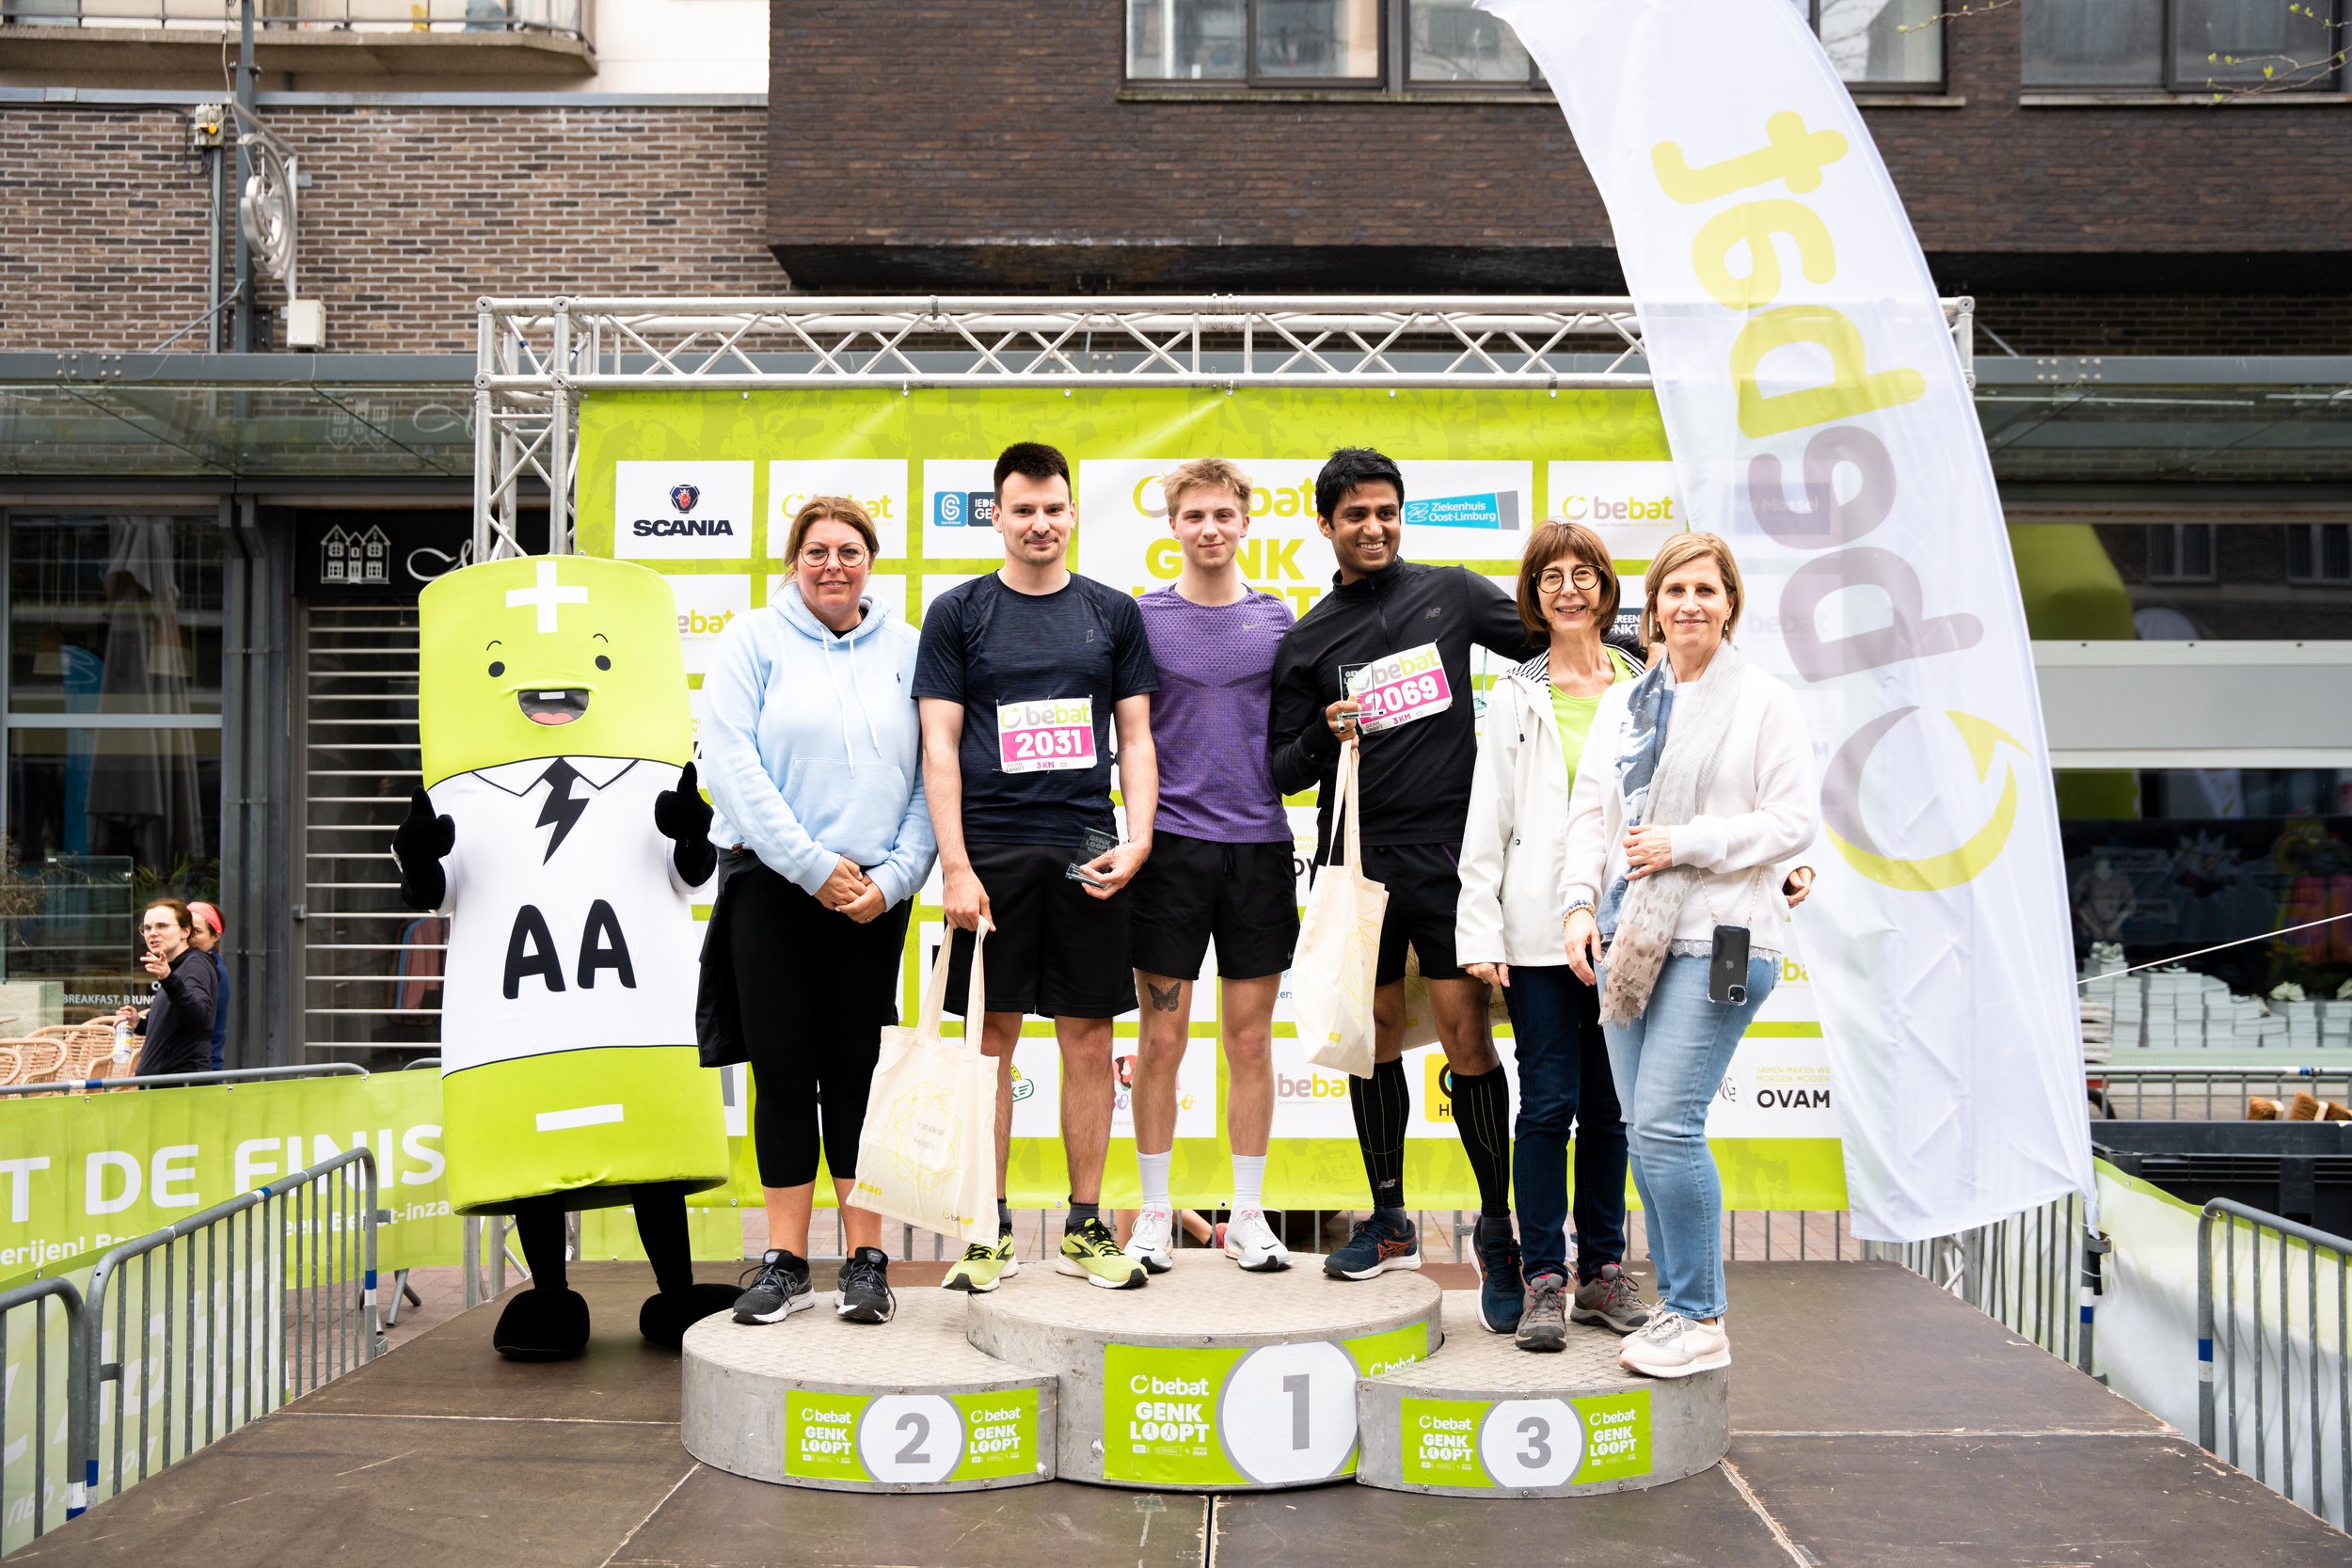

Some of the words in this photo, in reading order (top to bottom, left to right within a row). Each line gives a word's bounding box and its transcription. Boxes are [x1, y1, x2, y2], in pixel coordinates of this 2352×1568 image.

[1249, 477, 1318, 517] bat
[975, 508, 993, 519] GE
[1432, 502, 1486, 512] Ziekenhuis
[1594, 496, 1674, 520] bebat
[1429, 513, 1496, 522] Oost-Limburg
[633, 519, 734, 536] SCANIA
[1146, 538, 1305, 580] GNK
[1374, 648, 1440, 685] bebat
[1364, 675, 1438, 717] 2069
[1025, 702, 1090, 726] bebat
[1015, 729, 1082, 758] 2031
[1089, 835, 1111, 846] GENK
[503, 899, 637, 999] AA
[63, 994, 121, 1005] BREAKFAST,
[1756, 1090, 1830, 1108] OVAM
[85, 1144, 199, 1215] DE
[234, 1124, 446, 1200] FINIS
[0, 1236, 85, 1267] erijen!
[1152, 1376, 1209, 1396] bebat
[815, 1409, 852, 1425] bebat
[985, 1407, 1021, 1422] bebat
[1136, 1402, 1203, 1422] GENK
[1282, 1373, 1310, 1450] 1
[1603, 1409, 1636, 1425] bebat
[974, 1424, 1017, 1440] GENK
[1130, 1421, 1210, 1443] LOOPT
[1433, 1417, 1472, 1431] bebat
[805, 1426, 848, 1441] GENK
[895, 1412, 930, 1465] 2
[1423, 1433, 1468, 1448] GENK
[1517, 1416, 1551, 1469] 3
[1593, 1425, 1633, 1443] GENK
[801, 1439, 852, 1455] LOOPT
[970, 1437, 1021, 1454] LOOPT
[1419, 1446, 1473, 1462] LOOPT
[1590, 1438, 1637, 1457] LOOPT
